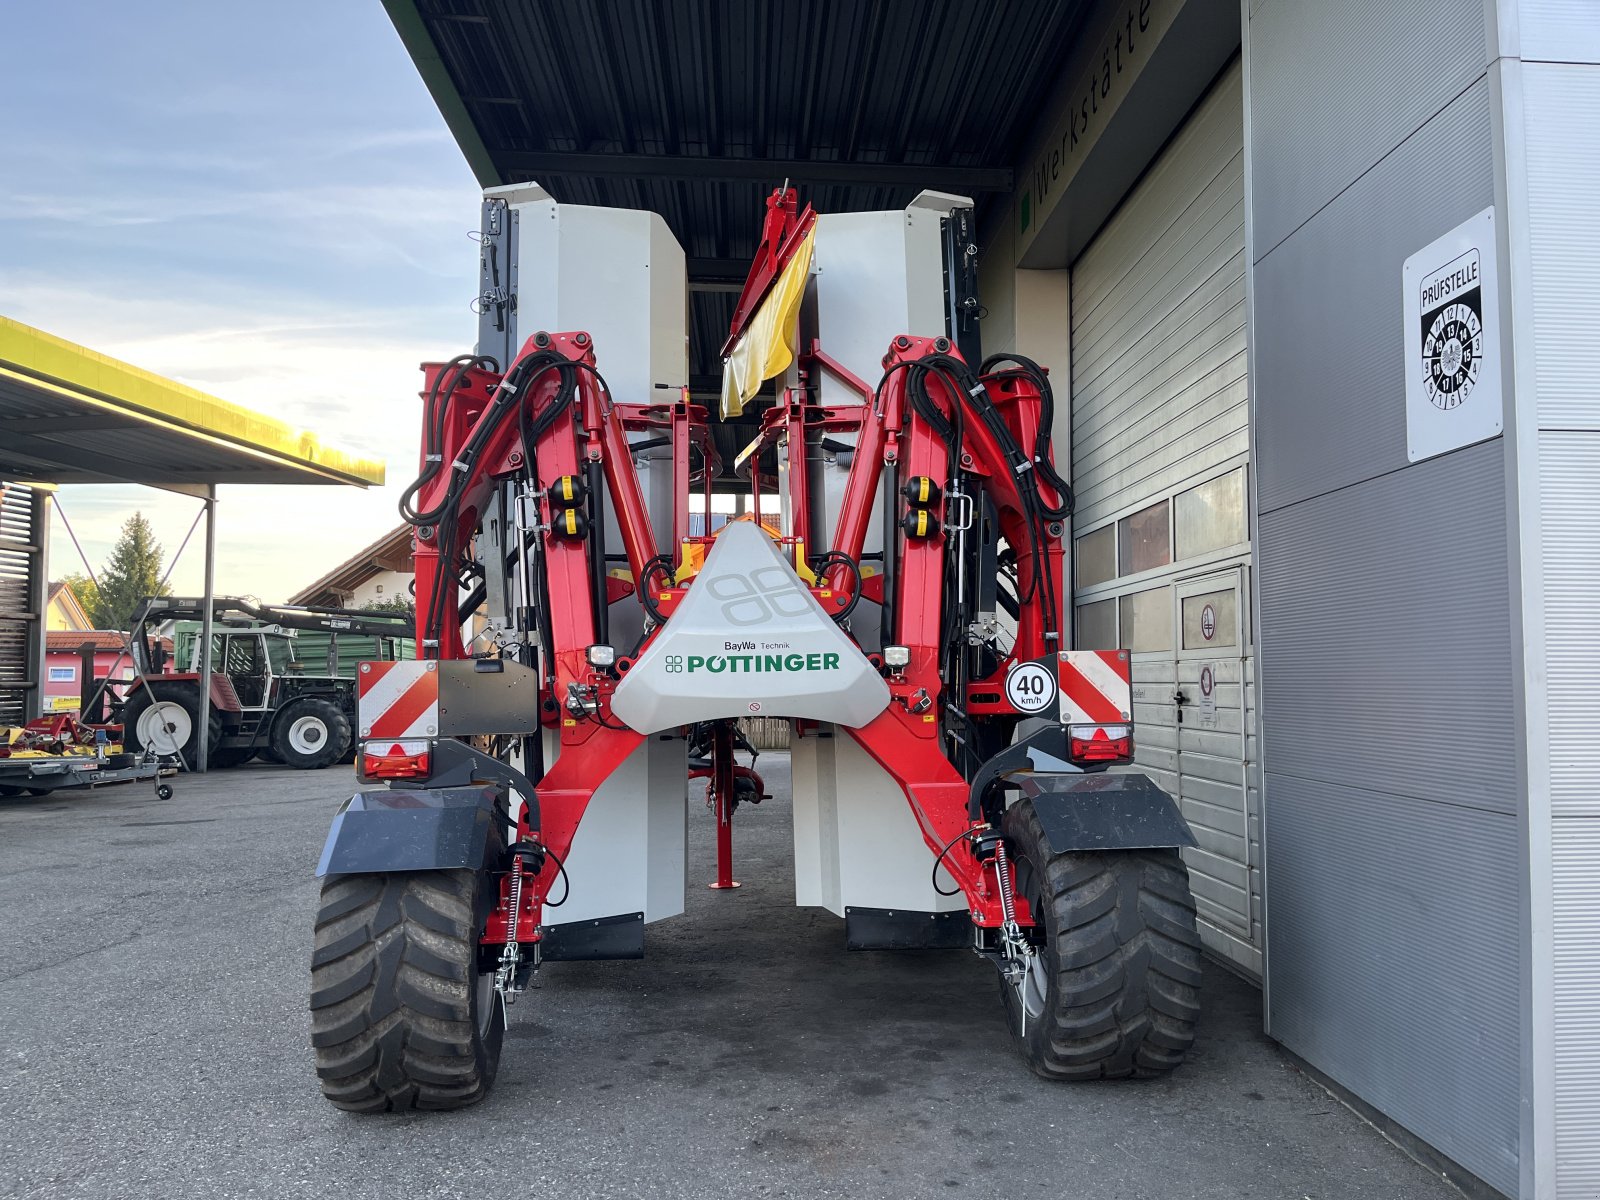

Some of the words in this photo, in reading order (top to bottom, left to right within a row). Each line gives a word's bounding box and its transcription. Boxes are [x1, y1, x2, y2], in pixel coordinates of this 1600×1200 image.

[1422, 261, 1477, 307] PRÜFSTELLE
[1447, 307, 1454, 320] 12
[1461, 308, 1464, 320] 1
[1435, 319, 1441, 332] 11
[1447, 324, 1454, 337] 13
[1471, 318, 1475, 330] 2
[1460, 328, 1467, 341] 14
[1426, 339, 1433, 351] 10
[1436, 340, 1443, 353] 19
[1475, 338, 1480, 350] 3
[1463, 348, 1471, 361] 15
[1425, 361, 1429, 374] 9
[1433, 362, 1440, 375] 18
[1473, 363, 1477, 375] 4
[1442, 377, 1449, 391] 17
[1456, 371, 1463, 385] 16
[1429, 382, 1433, 394] 8
[1463, 384, 1468, 396] 5
[1438, 394, 1442, 406] 7
[1451, 393, 1455, 406] 6
[724, 641, 756, 651] BayWa
[761, 641, 790, 650] Technik
[688, 653, 839, 673] PÖTTINGER
[1016, 675, 1044, 695] 40
[1021, 696, 1042, 704] km/h
